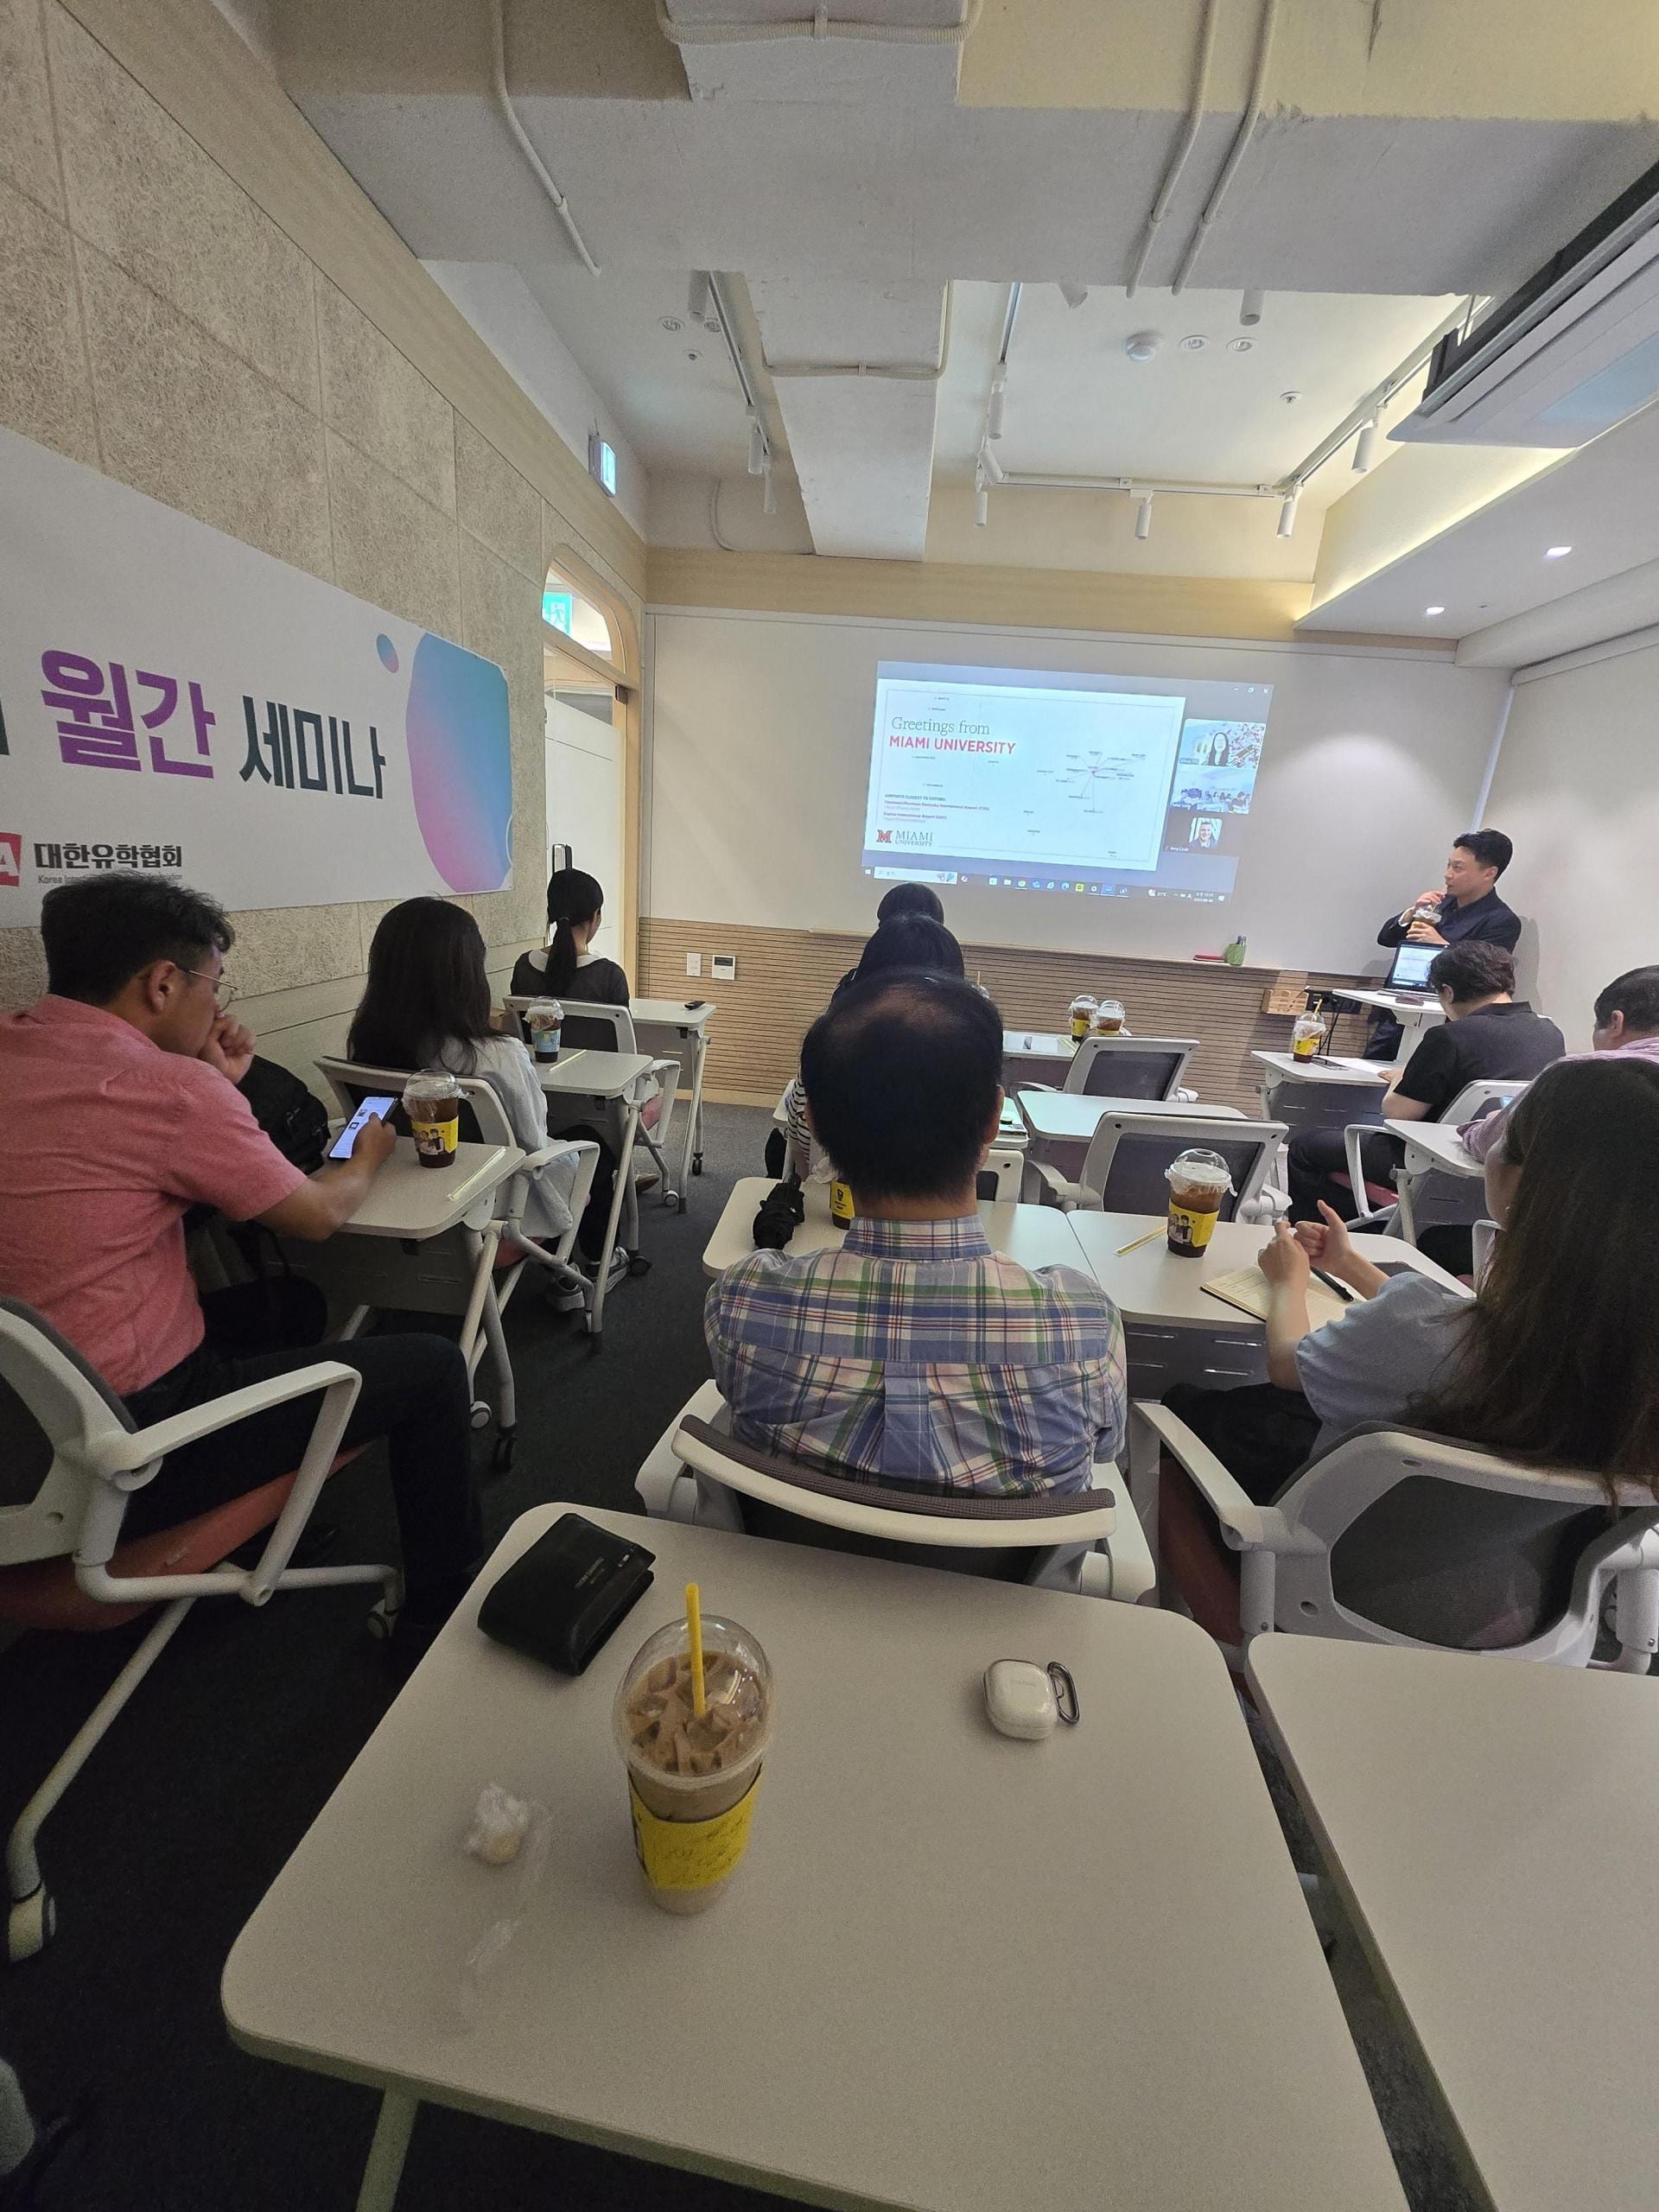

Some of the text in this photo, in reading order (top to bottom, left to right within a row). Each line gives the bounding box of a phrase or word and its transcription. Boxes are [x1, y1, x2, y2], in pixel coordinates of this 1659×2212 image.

[41, 649, 216, 779] 월간
[238, 695, 387, 799] 세미나
[892, 716, 990, 736] Greetings from
[889, 735, 1016, 754] MIAMI UNIVERSITY
[896, 830, 933, 841] MIAMI
[33, 842, 182, 869] 대한유학협회
[38, 874, 63, 885] Korea
